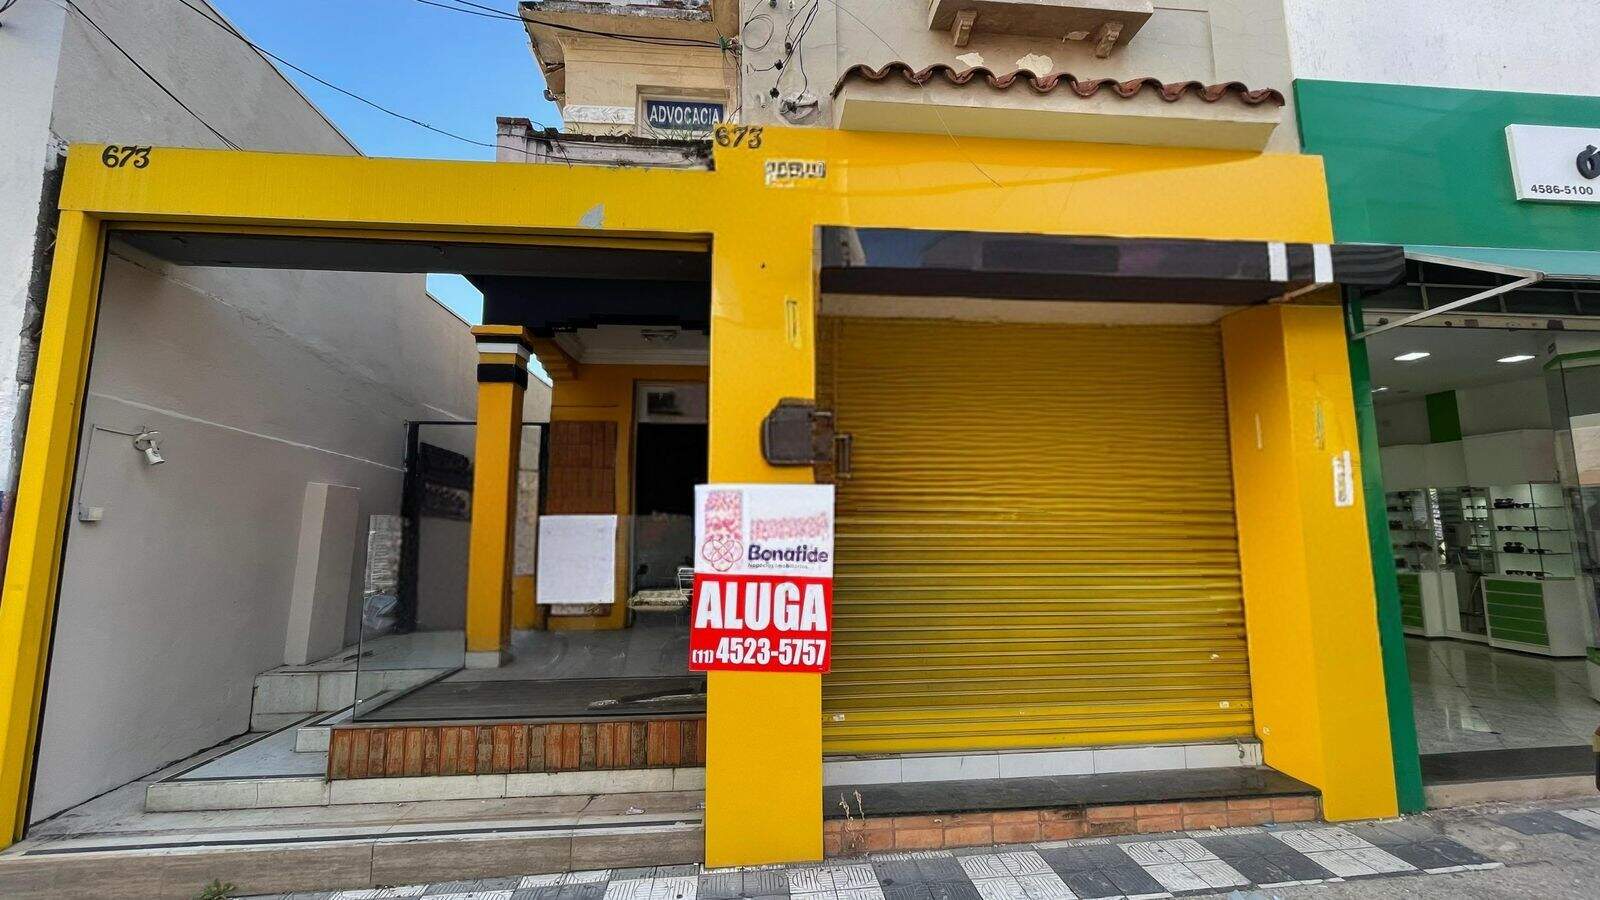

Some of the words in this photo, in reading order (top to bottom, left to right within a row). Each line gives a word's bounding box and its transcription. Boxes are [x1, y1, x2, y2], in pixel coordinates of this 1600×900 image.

[649, 105, 719, 125] ADVOCACIA
[715, 125, 763, 149] 673
[102, 145, 152, 169] 673
[1531, 184, 1593, 195] 4586-5100
[748, 544, 828, 563] Bonafide
[695, 581, 828, 632] ALUGA
[692, 649, 714, 664] (11)
[716, 637, 827, 666] 4523-5757
